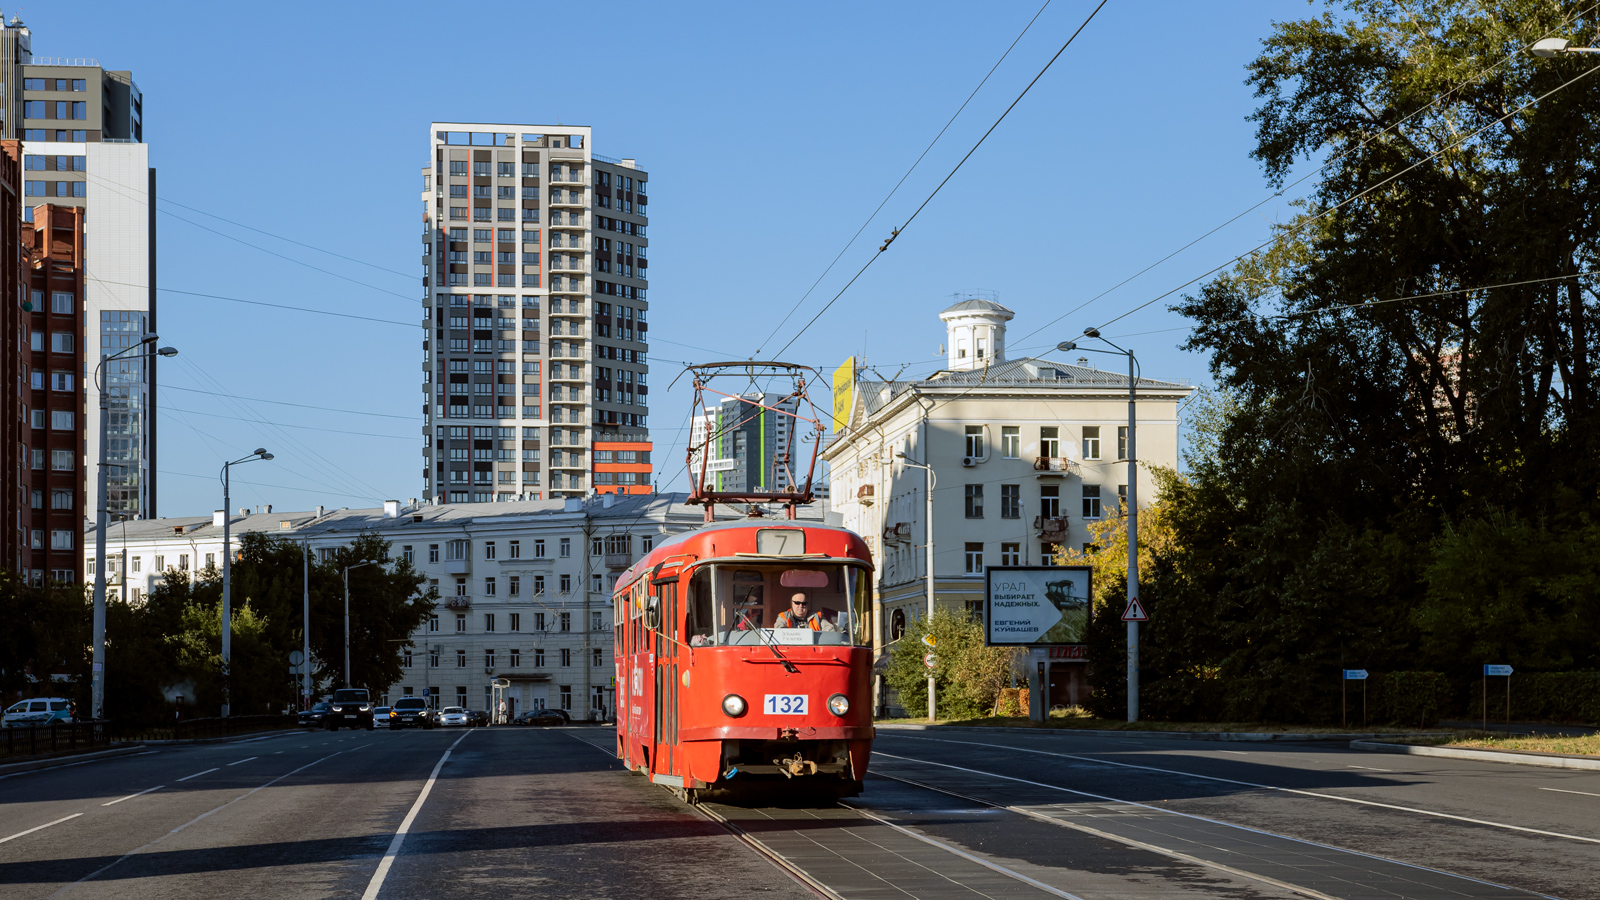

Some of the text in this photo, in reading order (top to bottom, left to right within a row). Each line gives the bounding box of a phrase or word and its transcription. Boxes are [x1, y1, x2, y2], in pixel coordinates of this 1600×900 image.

[775, 535, 788, 555] 7
[994, 582, 1026, 592] УРАЛ
[767, 696, 804, 713] 132
